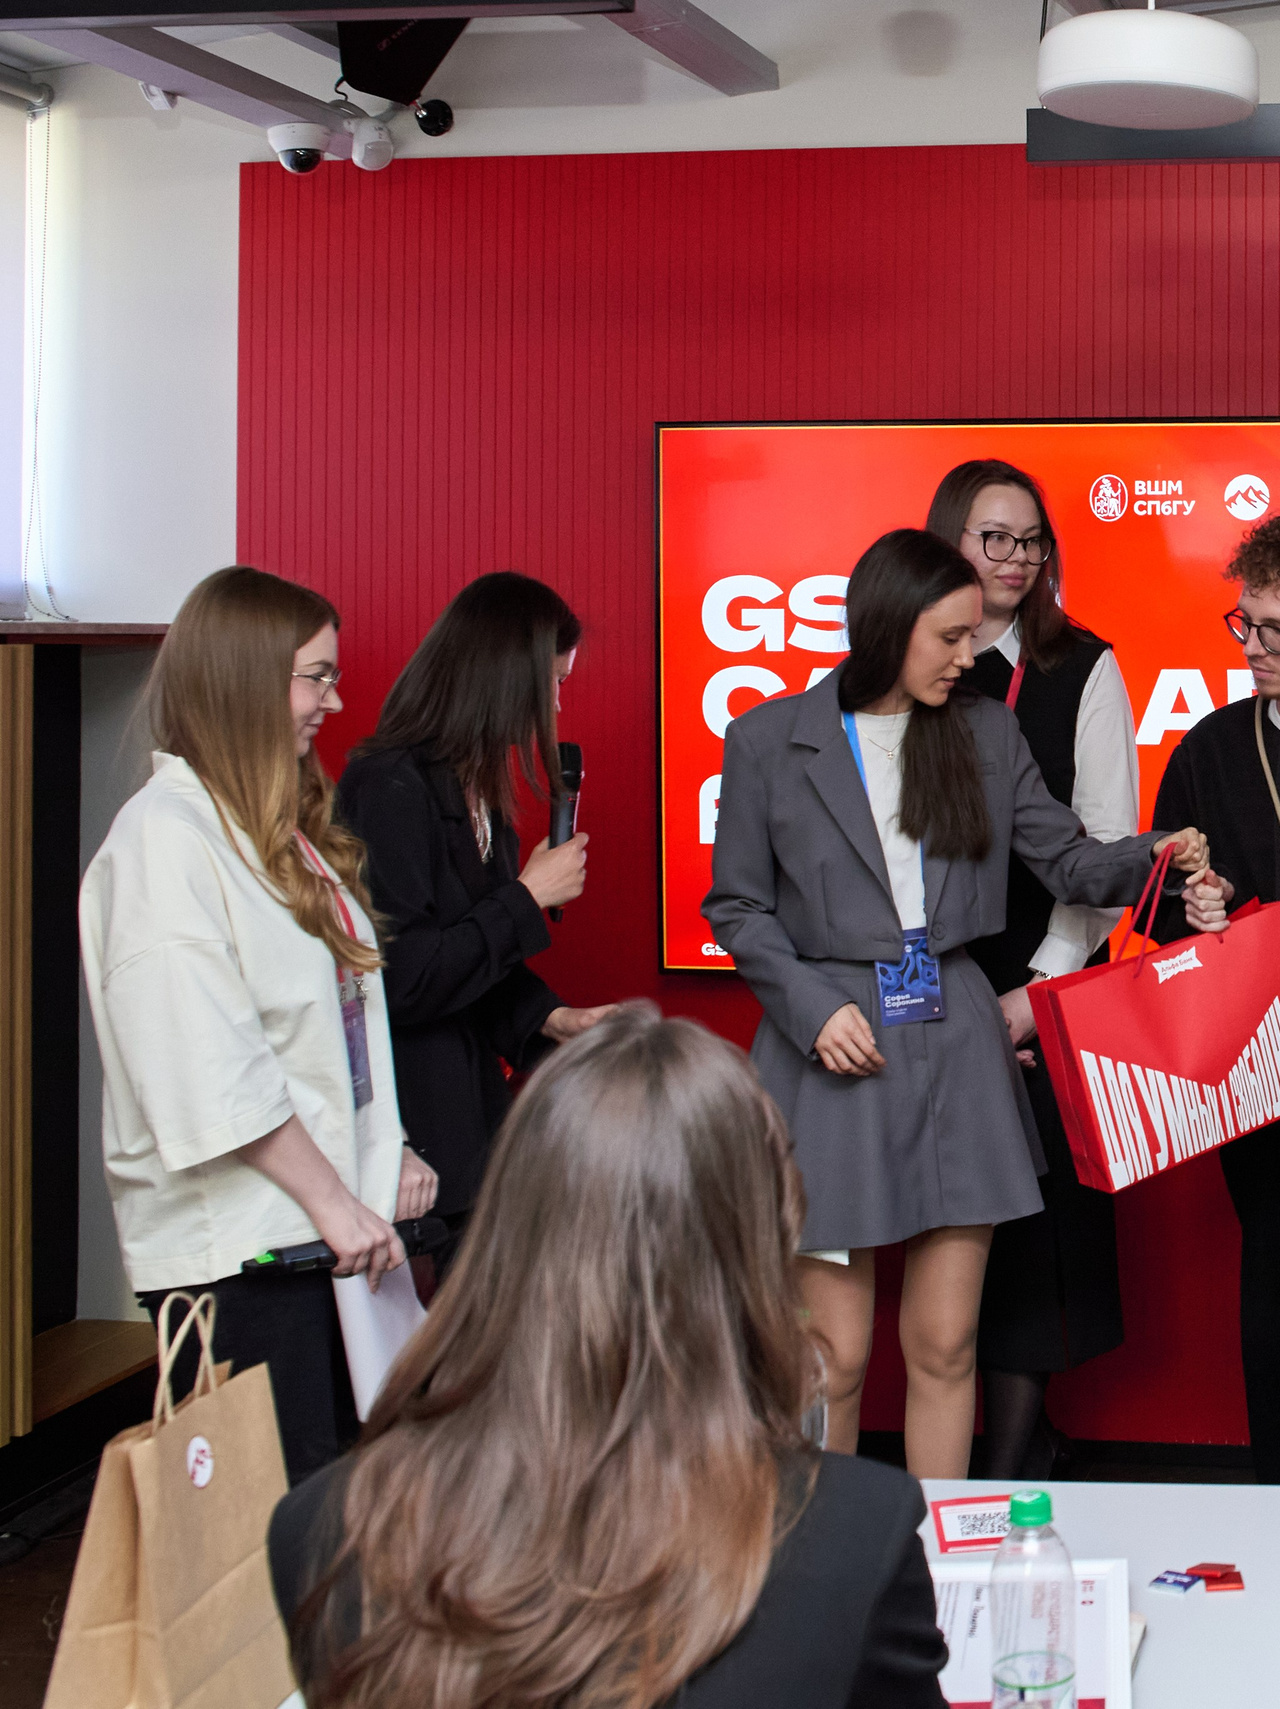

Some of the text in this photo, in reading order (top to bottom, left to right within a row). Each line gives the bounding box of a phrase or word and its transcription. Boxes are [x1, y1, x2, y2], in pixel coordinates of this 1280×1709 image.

[1133, 500, 1196, 516] СПбГУ
[1134, 480, 1182, 495] ВШМ
[701, 574, 851, 653] GS
[1080, 1050, 1154, 1191] ДЛЯ
[1131, 1063, 1226, 1171] УМНЫХ
[1218, 1079, 1236, 1139] И
